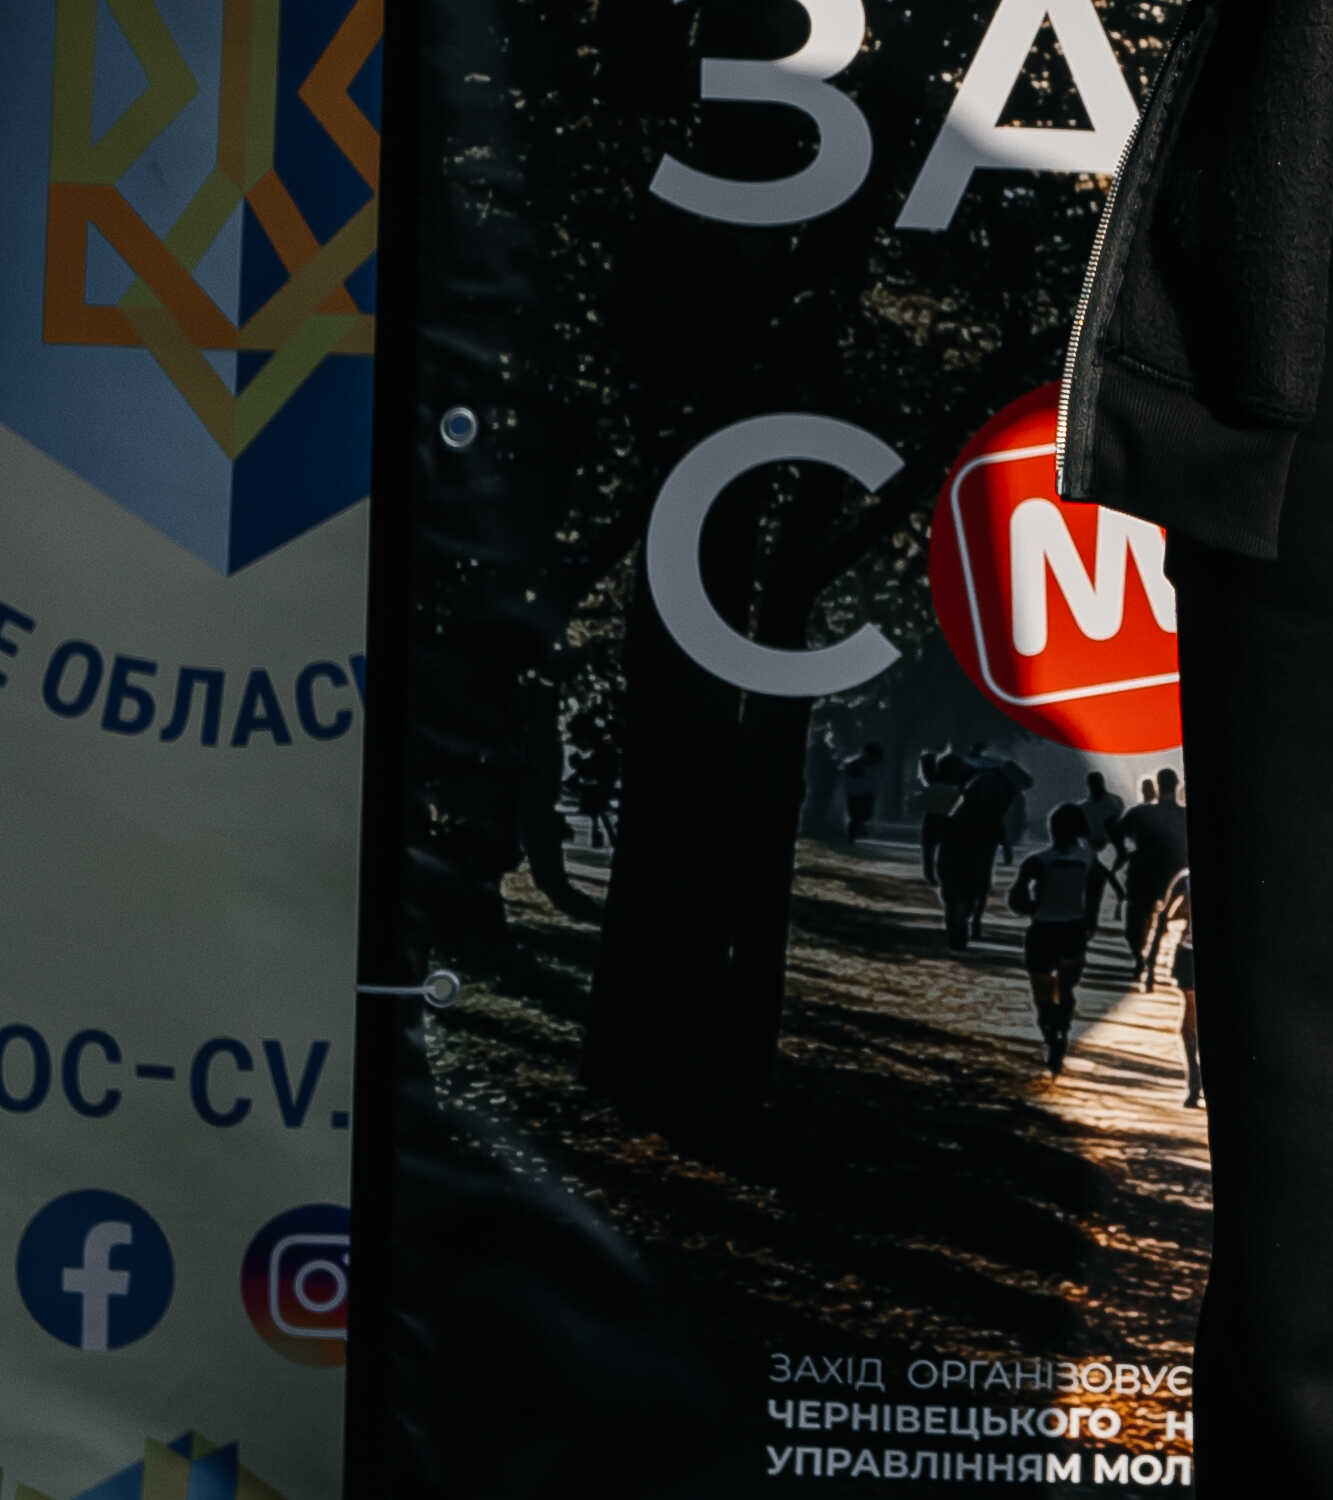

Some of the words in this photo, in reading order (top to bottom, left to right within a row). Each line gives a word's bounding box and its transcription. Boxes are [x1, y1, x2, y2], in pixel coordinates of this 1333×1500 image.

[42, 636, 367, 748] ОБЛАС
[769, 1352, 886, 1392] ЗАХІД
[767, 1398, 1122, 1442] ЧЕРНІВЕЦЬКОГО
[766, 1444, 1081, 1485] УПРАВЛІННЯМ
